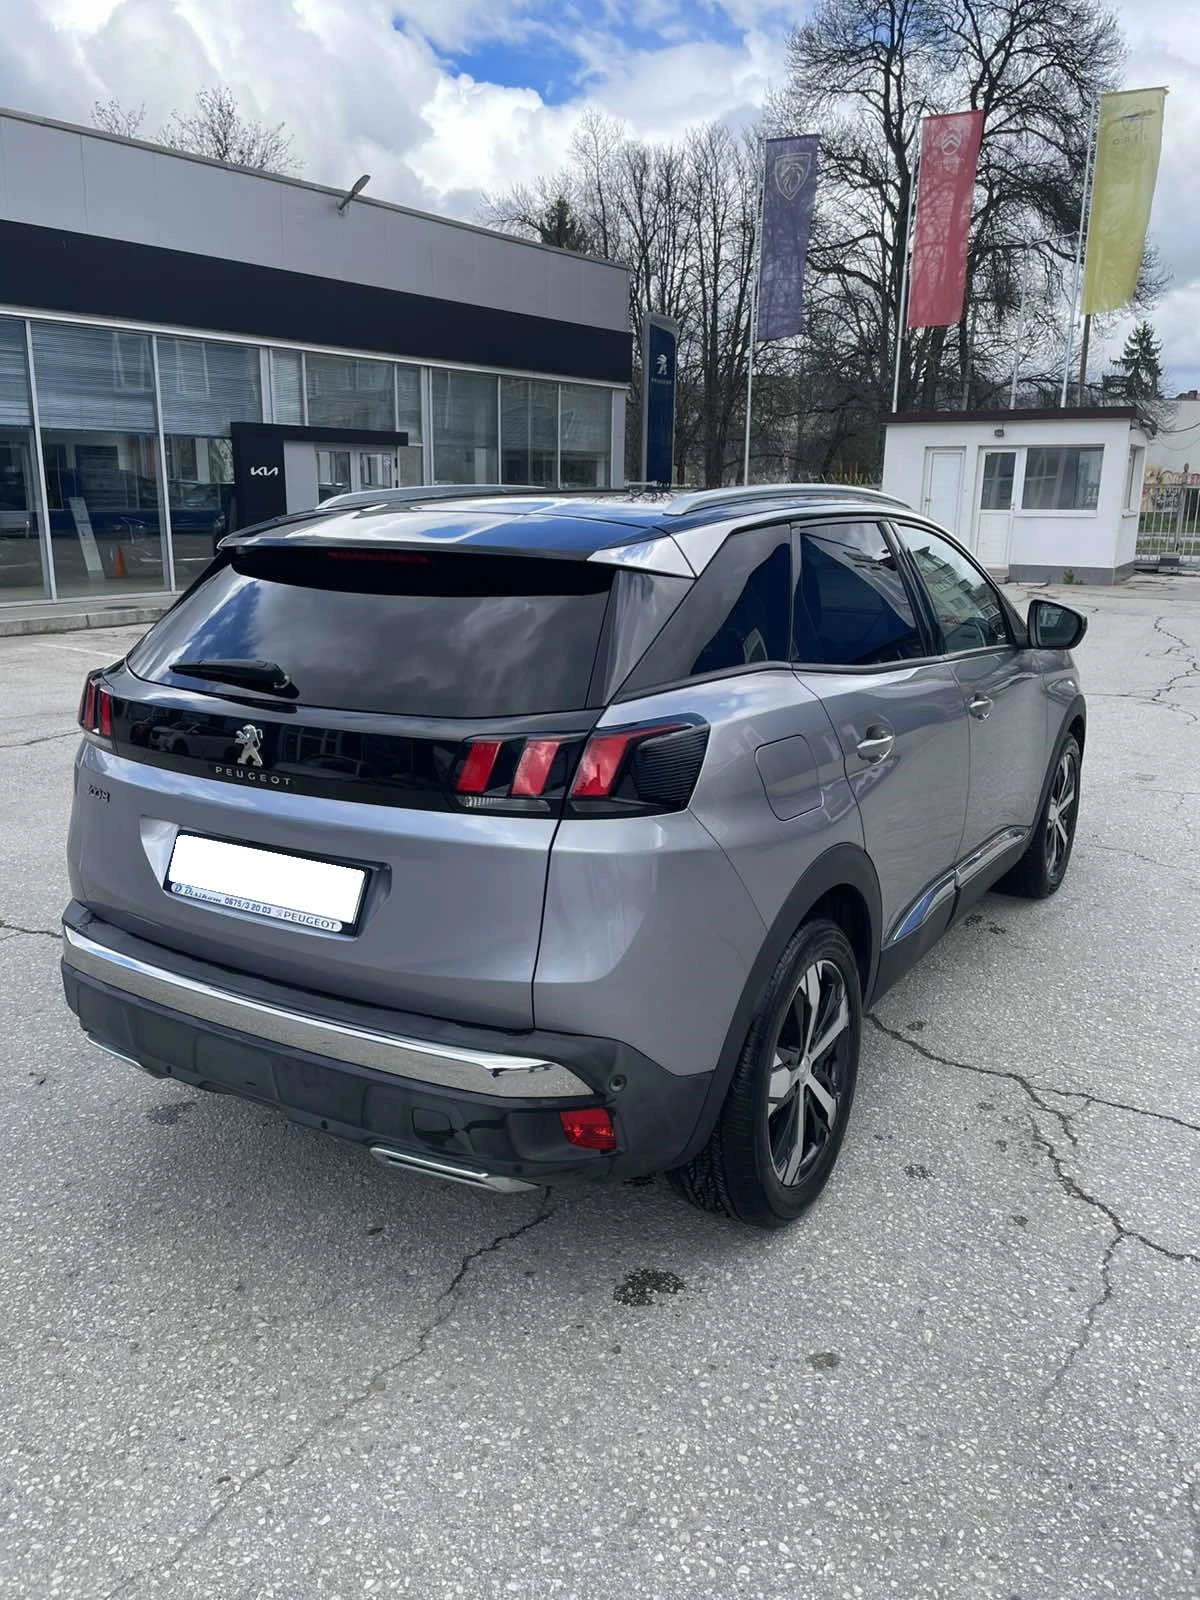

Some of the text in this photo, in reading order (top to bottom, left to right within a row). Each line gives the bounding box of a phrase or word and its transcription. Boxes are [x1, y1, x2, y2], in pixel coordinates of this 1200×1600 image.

[250, 466, 278, 476] KIA
[215, 765, 292, 786] PEUGEOT
[283, 911, 336, 930] PEUGEOT
